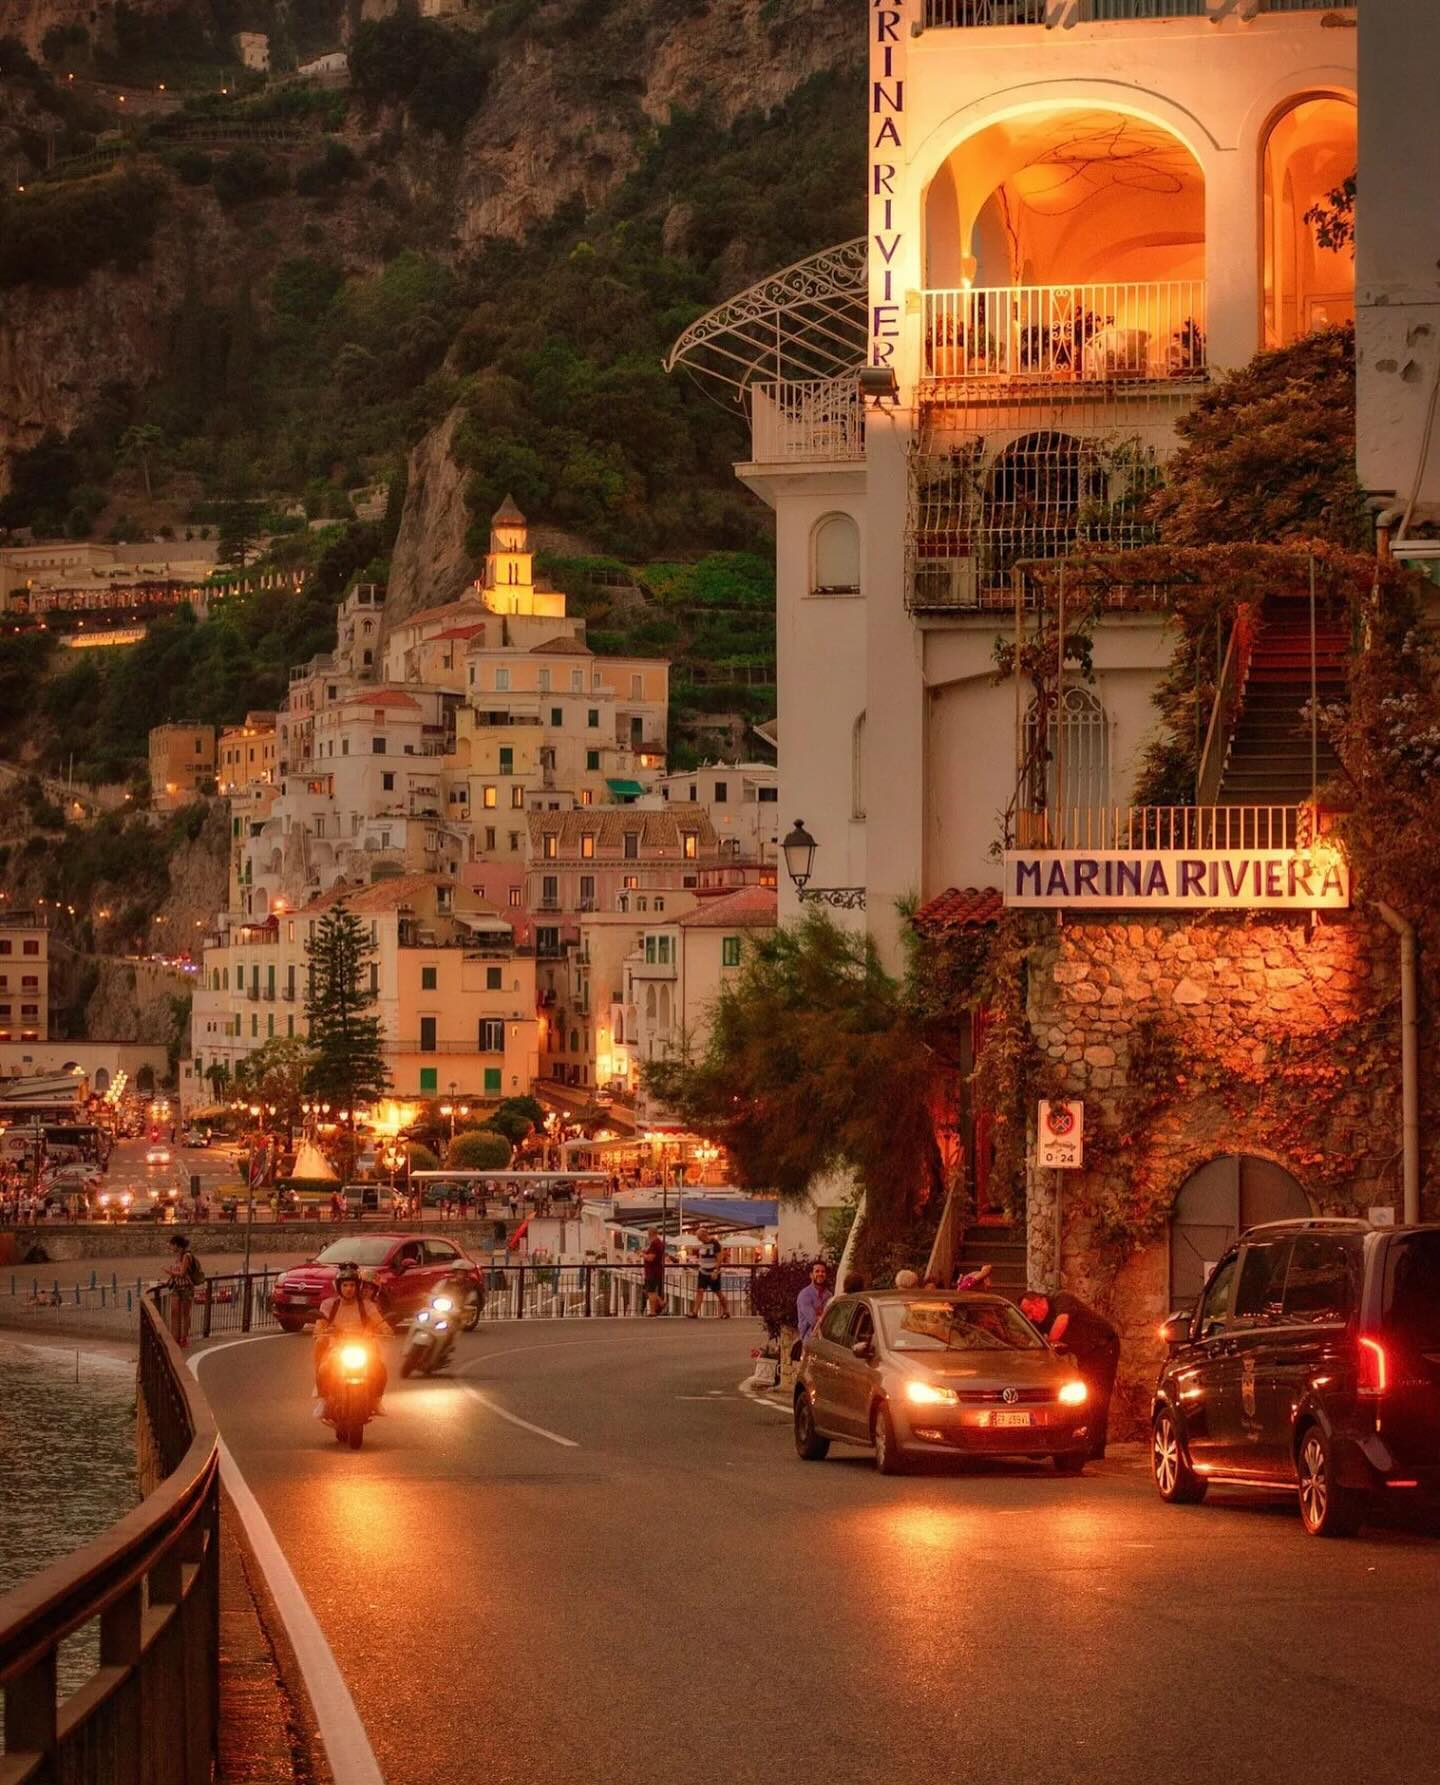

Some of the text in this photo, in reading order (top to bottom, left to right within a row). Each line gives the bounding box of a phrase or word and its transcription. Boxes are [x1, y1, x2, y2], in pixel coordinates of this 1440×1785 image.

[873, 0, 904, 148] RINA
[1016, 859, 1345, 897] MARINA RIVIERA
